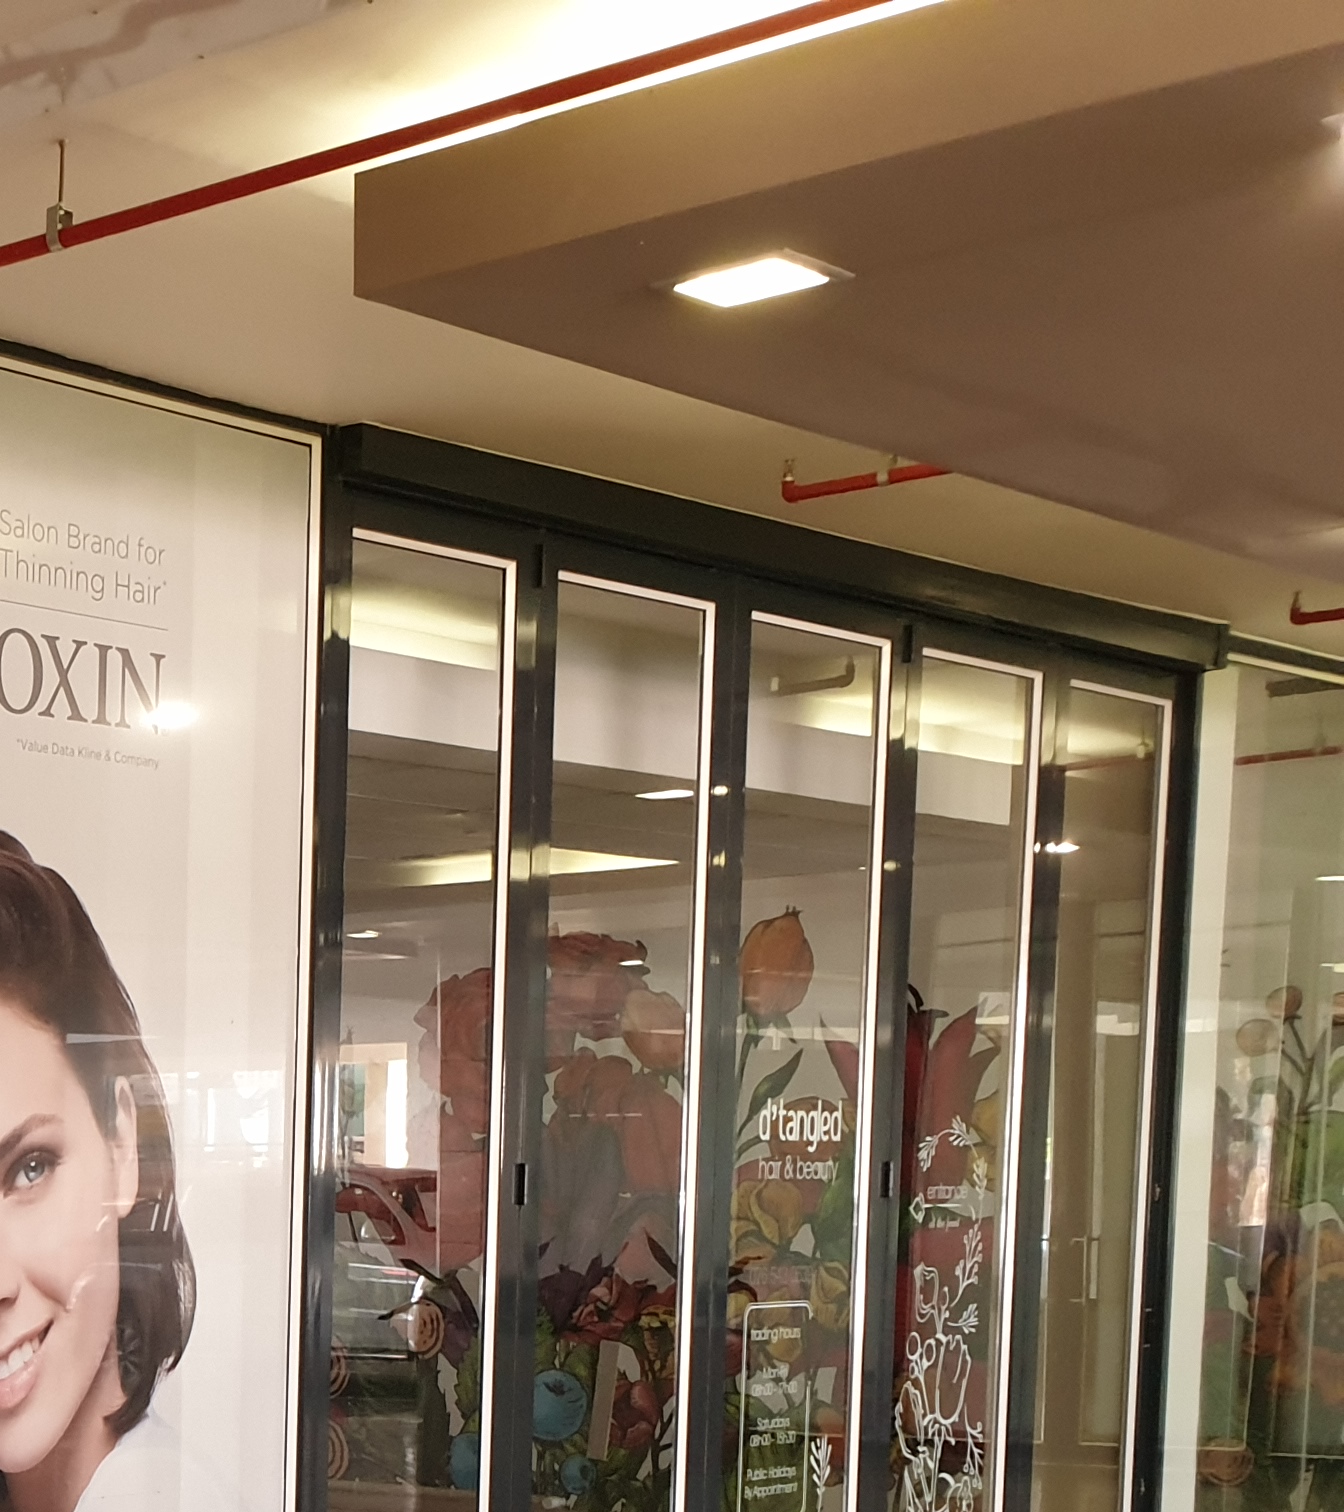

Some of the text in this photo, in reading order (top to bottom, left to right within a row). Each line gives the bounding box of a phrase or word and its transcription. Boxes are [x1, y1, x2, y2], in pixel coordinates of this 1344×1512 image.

[0, 509, 166, 566] Salon Brand for
[0, 548, 105, 602] Thinning
[52, 742, 76, 758] Data
[104, 750, 112, 762] &
[114, 751, 160, 770] Company
[758, 1155, 839, 1185] hair & beauty
[779, 1327, 801, 1339] hours
